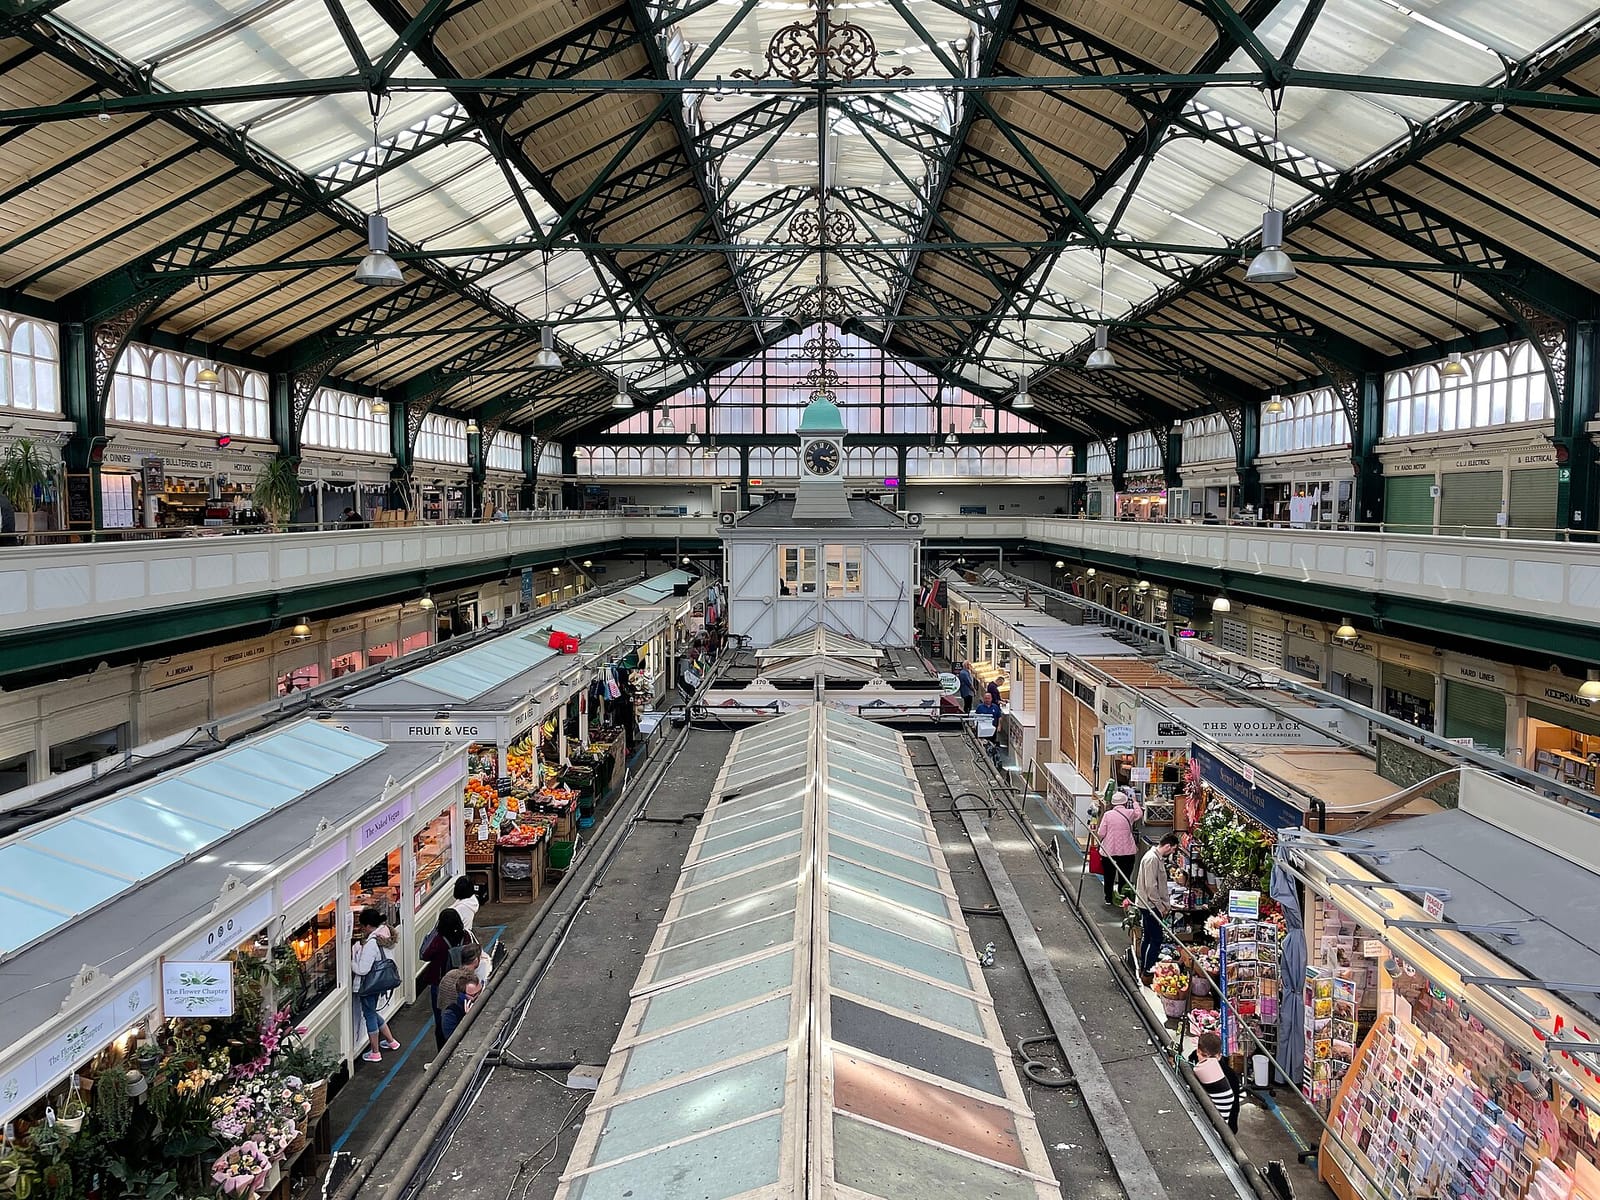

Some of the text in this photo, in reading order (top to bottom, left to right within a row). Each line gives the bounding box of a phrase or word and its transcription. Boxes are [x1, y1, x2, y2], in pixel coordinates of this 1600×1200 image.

[111, 454, 131, 463] DINNER
[1468, 459, 1490, 467] ELECTRICS
[1525, 455, 1552, 463] ELECTRICAL
[200, 461, 212, 469] CAFE
[1460, 668, 1495, 682] HARD LINES
[1544, 687, 1590, 707] KEEPSAKES
[408, 726, 478, 735] FRUIT & VEG
[1203, 722, 1301, 730] THE WOOLPACK
[1425, 894, 1443, 911] FRAGILE
[1427, 904, 1440, 917] ROOF
[81, 972, 93, 986] 140
[202, 988, 228, 996] Chapter
